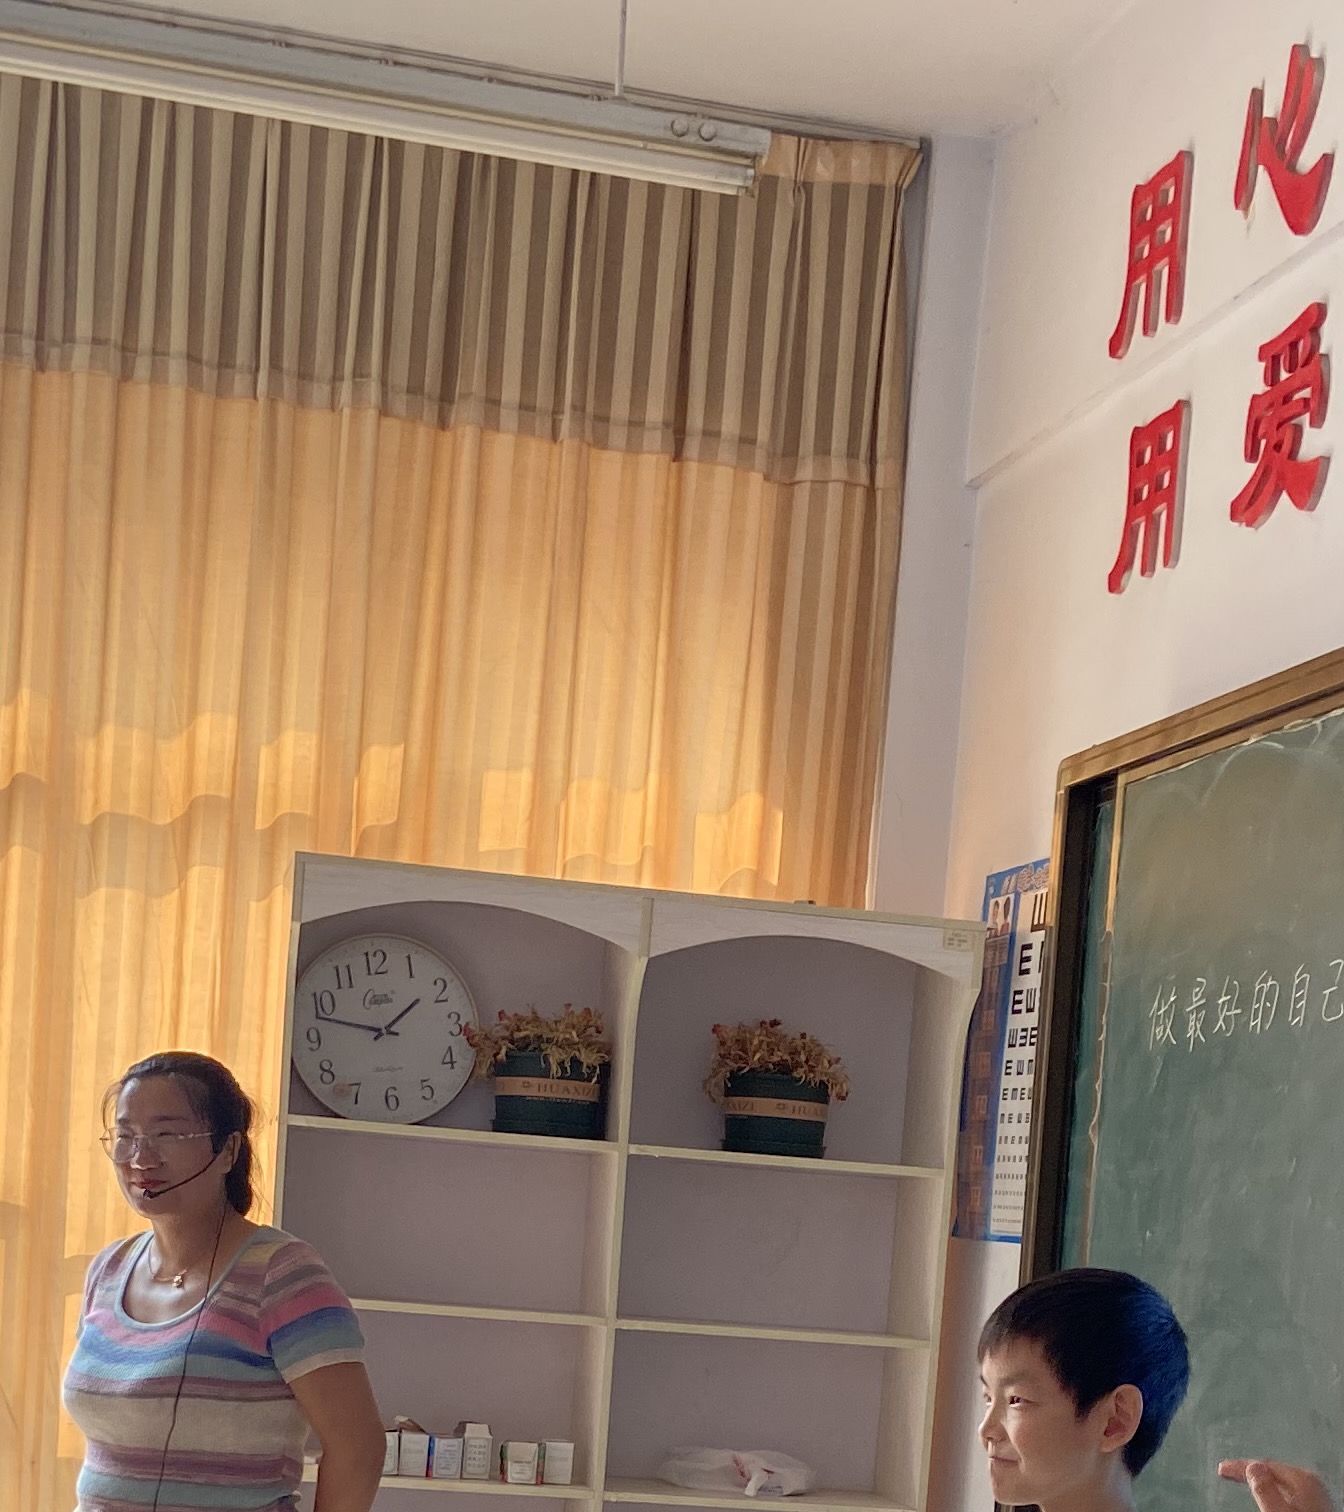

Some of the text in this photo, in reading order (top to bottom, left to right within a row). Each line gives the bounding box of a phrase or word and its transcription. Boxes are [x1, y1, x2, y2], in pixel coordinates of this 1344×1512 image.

[363, 949, 388, 976] 12
[405, 953, 416, 979] 1
[333, 963, 354, 990] 11
[433, 977, 449, 1004] 2
[312, 989, 336, 1019] 10
[1149, 959, 1344, 1052] 做最好的自己
[447, 1011, 463, 1037] 3
[306, 1026, 322, 1052] 9
[441, 1045, 457, 1070] 4
[318, 1058, 336, 1085] 8
[348, 1082, 362, 1105] 7
[384, 1086, 400, 1111] 6
[419, 1078, 435, 1101] 5
